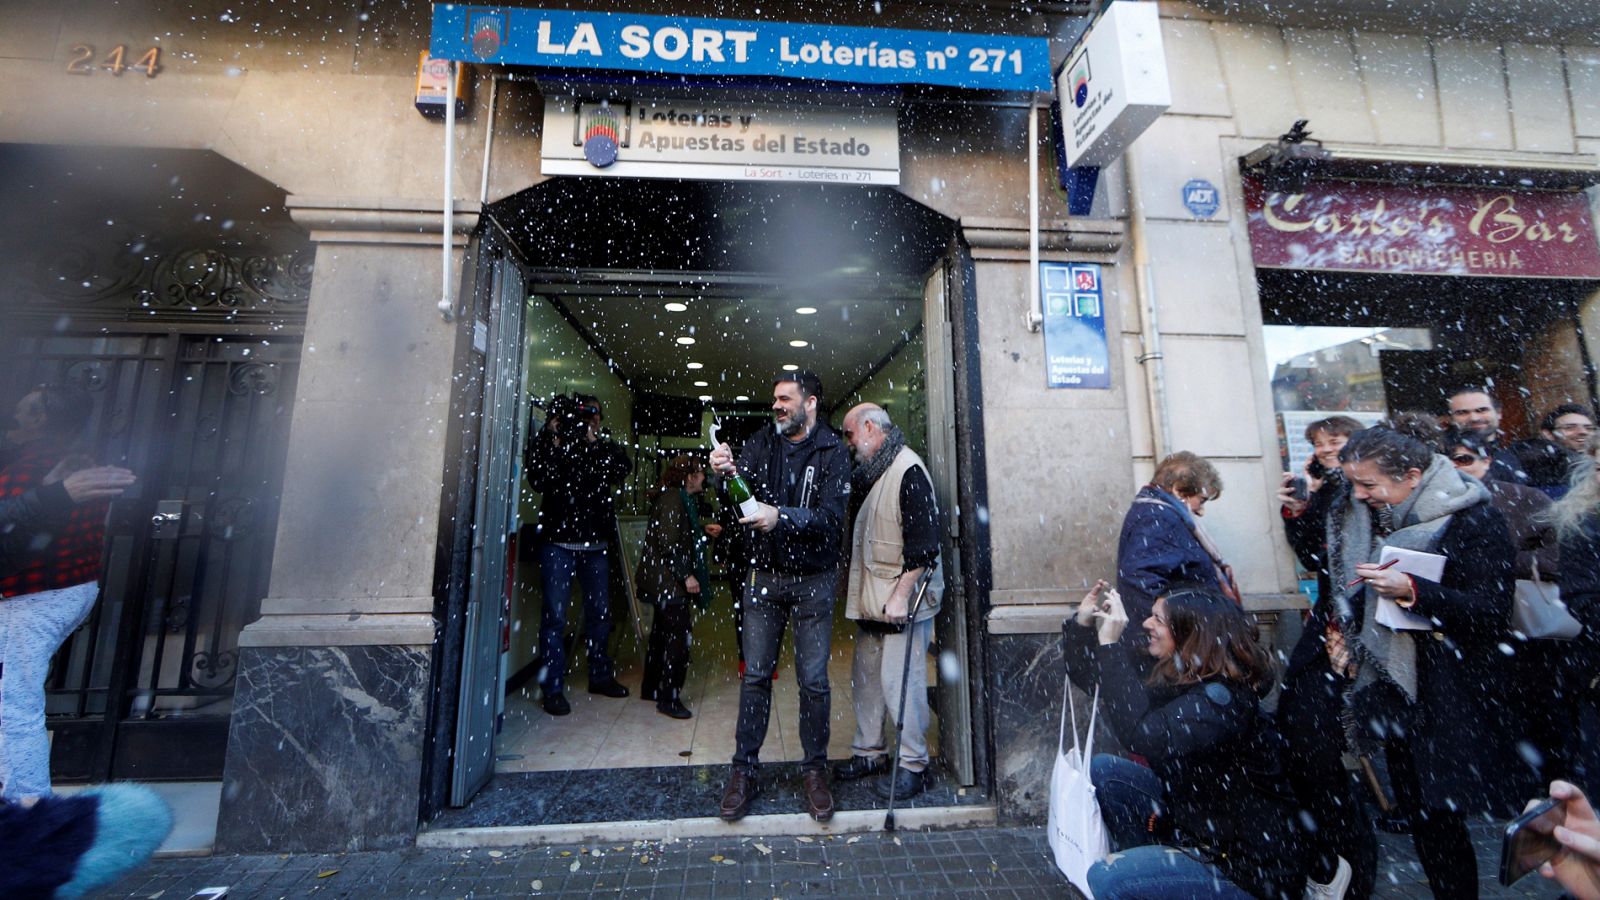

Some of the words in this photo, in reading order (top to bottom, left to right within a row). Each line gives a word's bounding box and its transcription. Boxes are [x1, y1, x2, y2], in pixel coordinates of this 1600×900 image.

[536, 20, 603, 56] LA
[619, 24, 758, 63] SORT
[779, 36, 917, 69] Loterías
[968, 48, 1023, 75] 271
[66, 44, 159, 78] 244
[639, 107, 732, 129] Loterías
[740, 115, 752, 134] y
[638, 131, 746, 153] Apuestas
[752, 133, 786, 153] del
[793, 136, 871, 157] Estado
[744, 167, 757, 178] La
[760, 168, 783, 178] Sort
[798, 169, 839, 180] Loteries
[856, 171, 872, 182] 271
[1187, 189, 1214, 204] ADT
[1468, 195, 1580, 244] Bar
[1339, 246, 1523, 270] SANDWICHERIA
[1051, 365, 1090, 376] Apuestas
[1091, 365, 1105, 375] del
[1051, 375, 1082, 385] Estado
